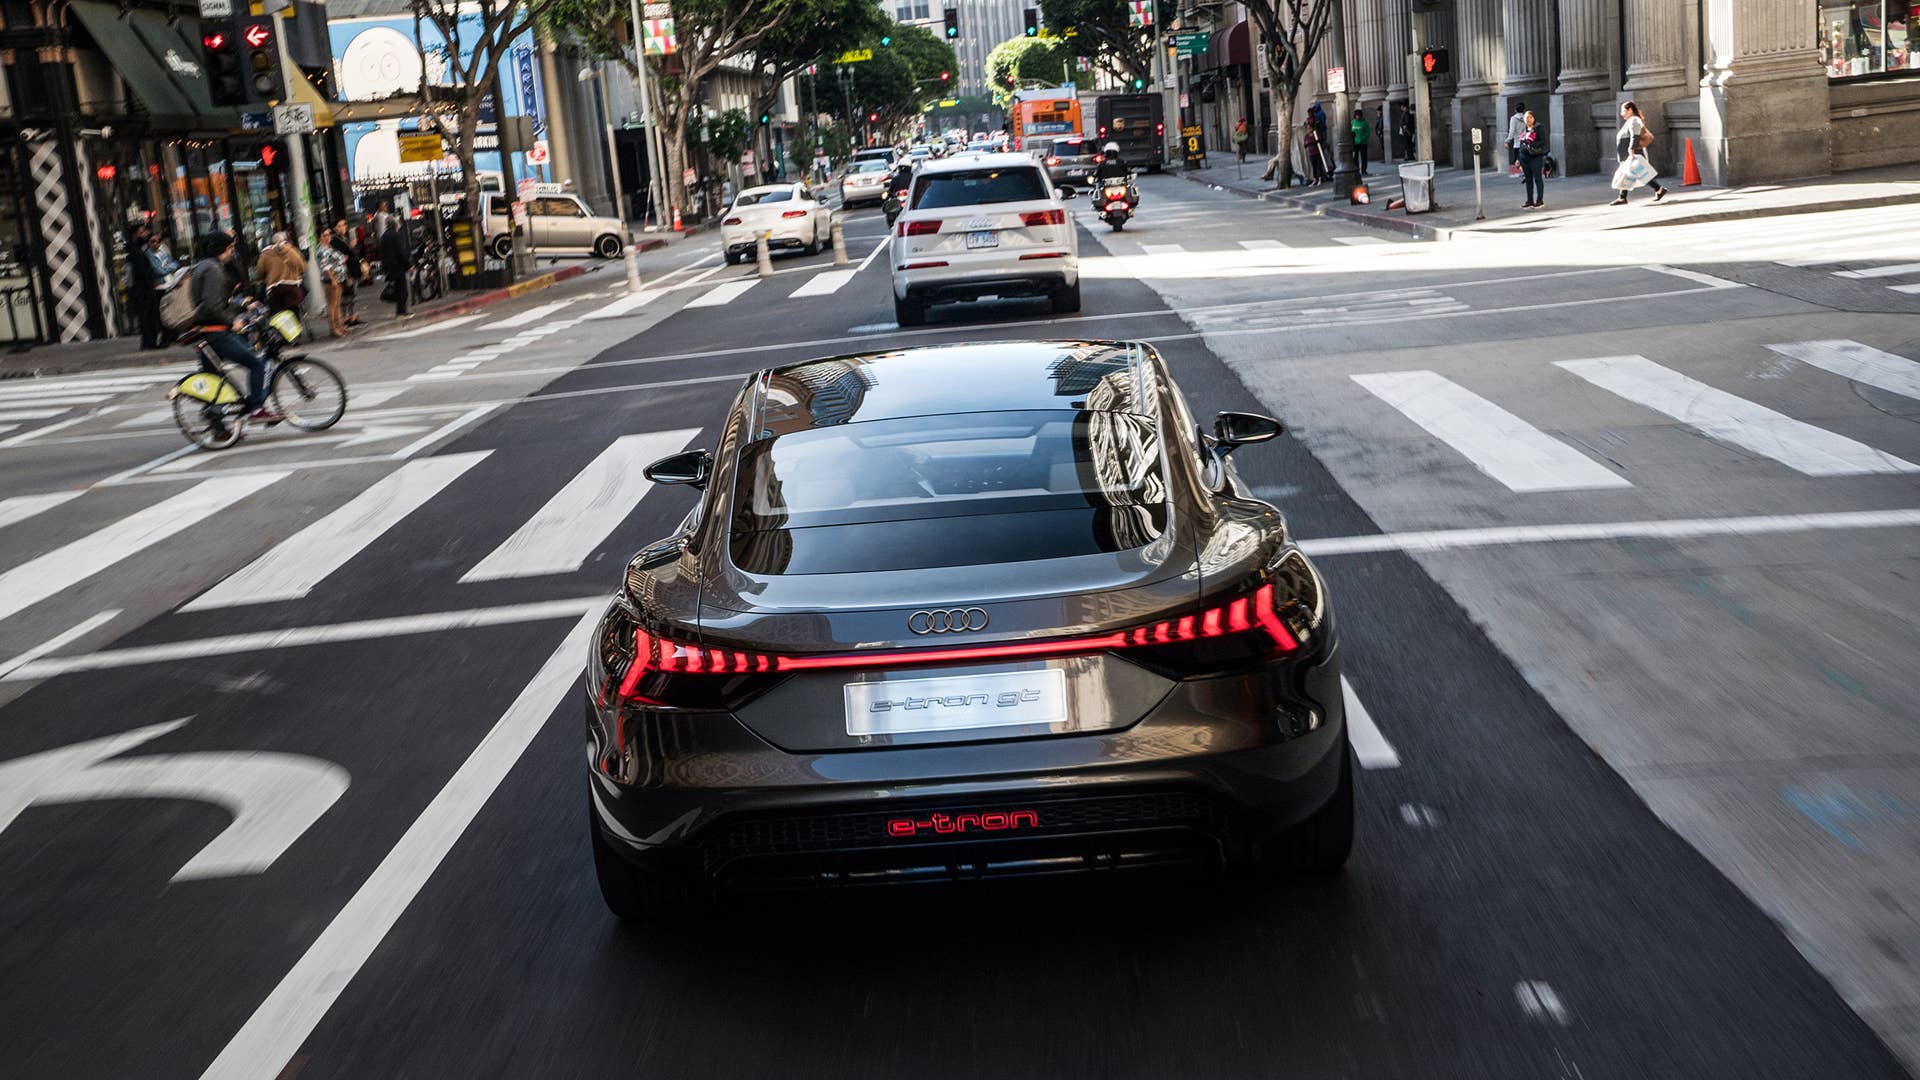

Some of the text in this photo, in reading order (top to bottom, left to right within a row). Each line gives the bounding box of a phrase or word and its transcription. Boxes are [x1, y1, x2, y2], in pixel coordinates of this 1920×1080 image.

[869, 688, 1041, 713] e-tron gt
[887, 810, 1039, 837] e-tron
